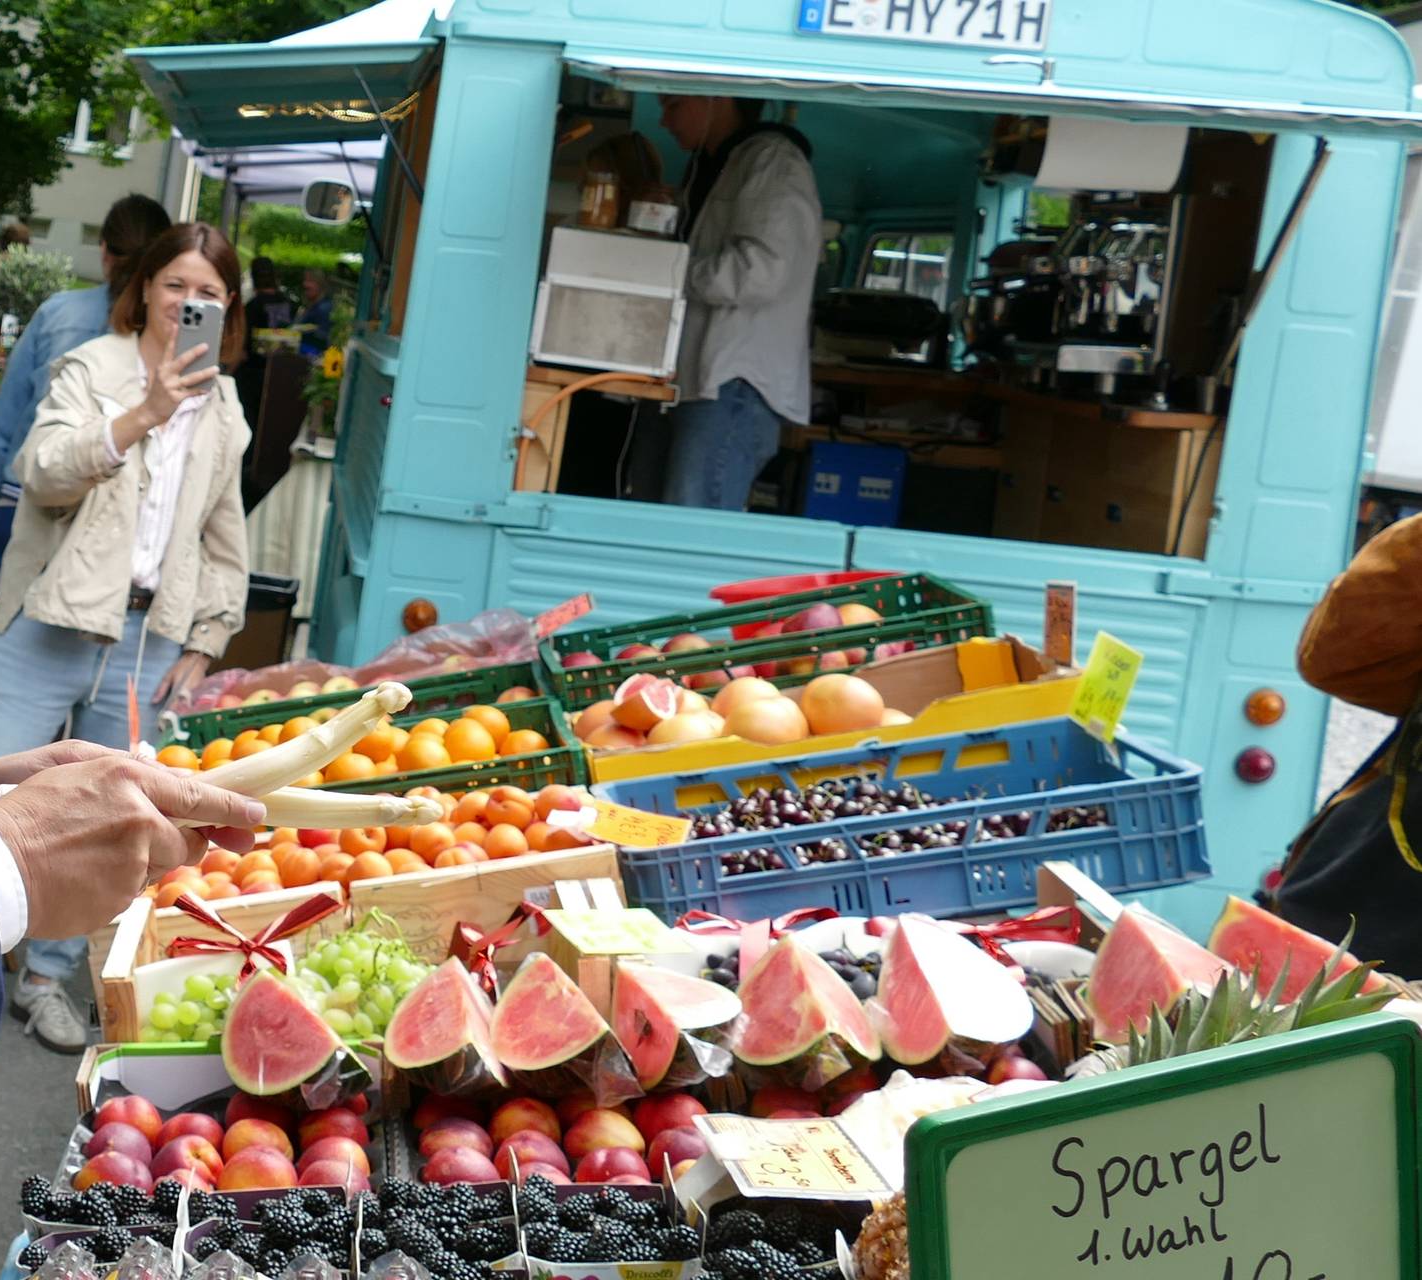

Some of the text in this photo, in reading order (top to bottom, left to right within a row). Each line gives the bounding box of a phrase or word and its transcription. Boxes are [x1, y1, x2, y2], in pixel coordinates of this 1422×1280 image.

[1052, 1103, 1280, 1218] Spargel
[1077, 1208, 1228, 1265] 1. Wahl
